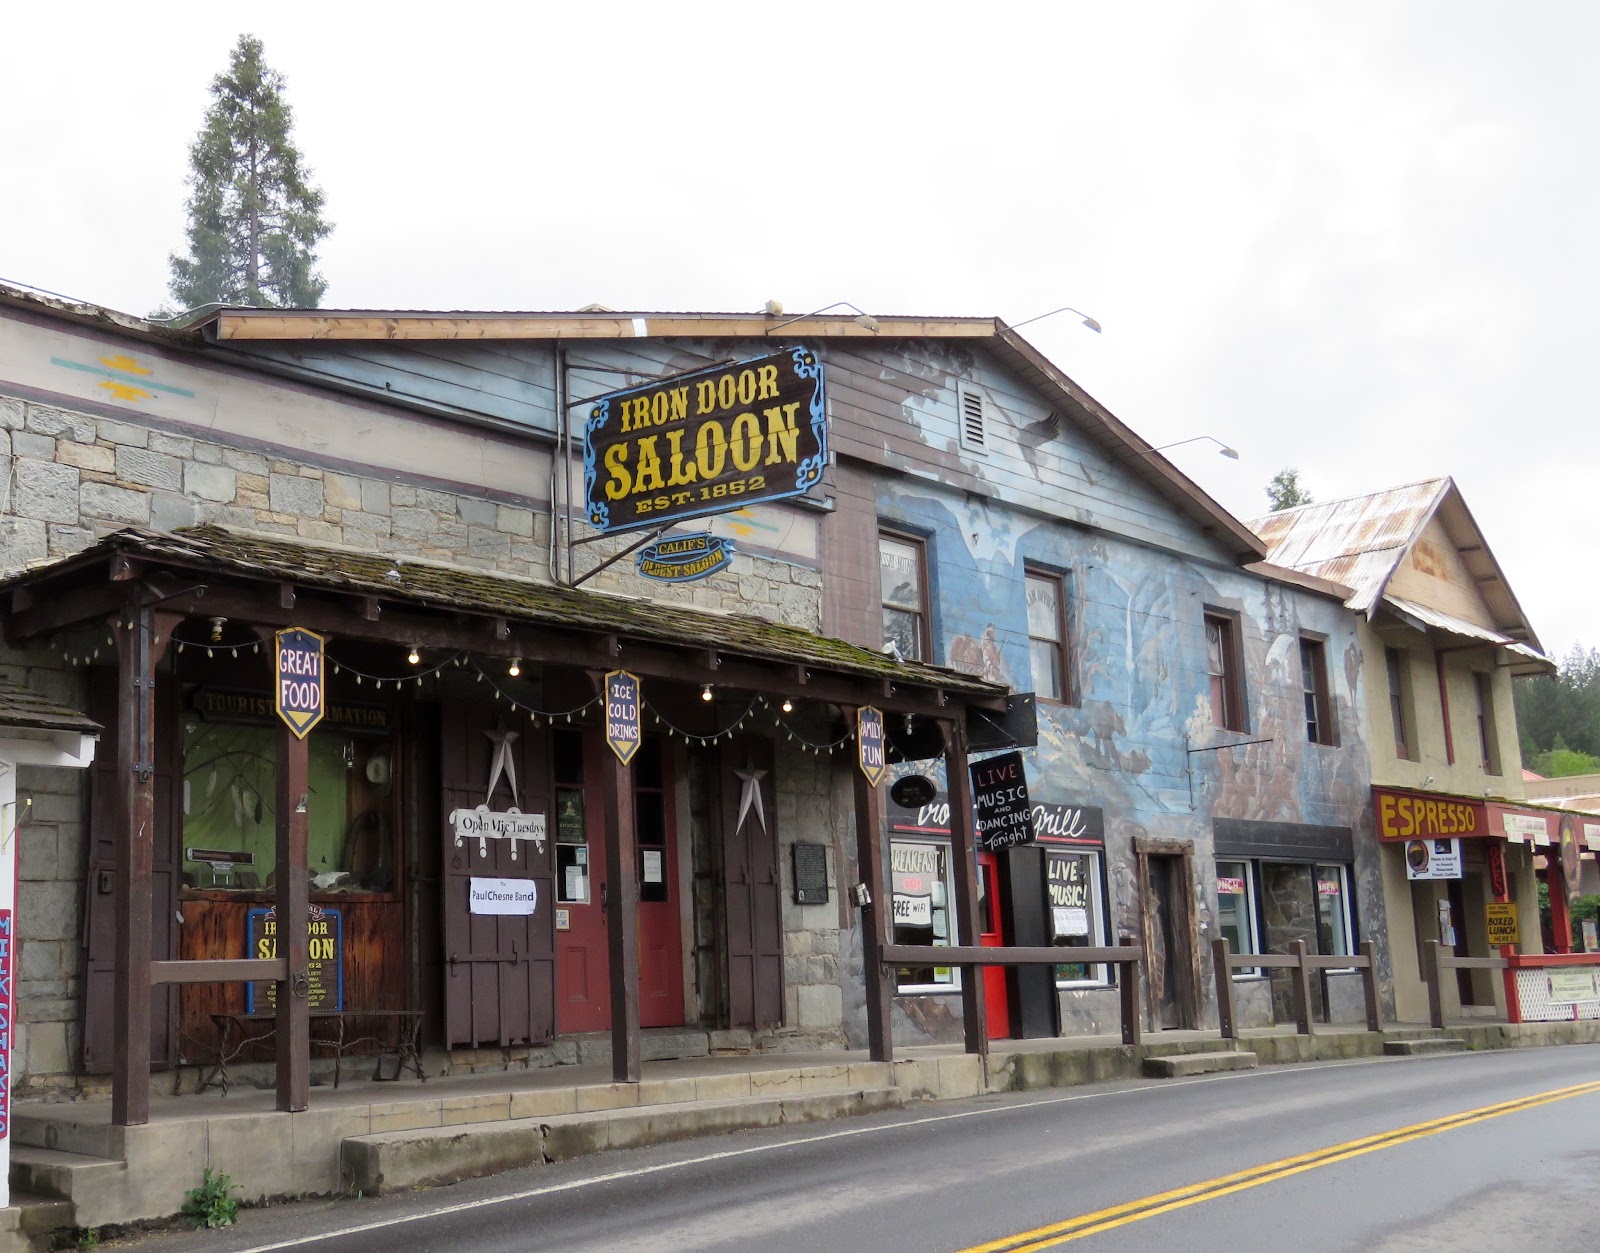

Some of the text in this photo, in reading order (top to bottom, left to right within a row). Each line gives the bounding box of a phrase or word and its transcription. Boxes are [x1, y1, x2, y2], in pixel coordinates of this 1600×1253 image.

[620, 364, 779, 433] IRON DOOR
[604, 401, 800, 501] SALOON
[635, 475, 766, 514] EST. 1852
[658, 537, 705, 555] CALIF'S
[641, 547, 723, 578] OLDEST SALOON
[279, 648, 319, 677] GREAT
[280, 679, 320, 710] FOOD
[613, 683, 632, 700] ICE
[205, 693, 387, 727] TOURIST RMATION
[608, 702, 636, 721] COLD
[609, 723, 638, 741] DRINKS
[860, 720, 881, 739] FAMILY
[861, 744, 882, 766] FUN
[977, 763, 1017, 787] LIVE
[976, 785, 1026, 809] MUSIC
[979, 808, 1031, 832] DANCING
[994, 805, 1011, 814] AND
[1380, 795, 1475, 837] ESPRESSO
[462, 817, 489, 833] Open
[491, 819, 510, 834] Mic
[510, 820, 544, 836] Tuesdays
[917, 802, 950, 826] Iro
[1031, 804, 1087, 841] Grill
[984, 825, 1027, 851] Tonight
[1048, 859, 1078, 881] LIVE
[902, 877, 924, 891] OPEN
[1048, 883, 1088, 907] MUSIC!
[1217, 879, 1239, 890] UNCH
[514, 891, 534, 901] Band
[892, 900, 926, 917] FREE WIFI
[1488, 917, 1514, 926] BOXED
[1489, 926, 1516, 935] LUNCH
